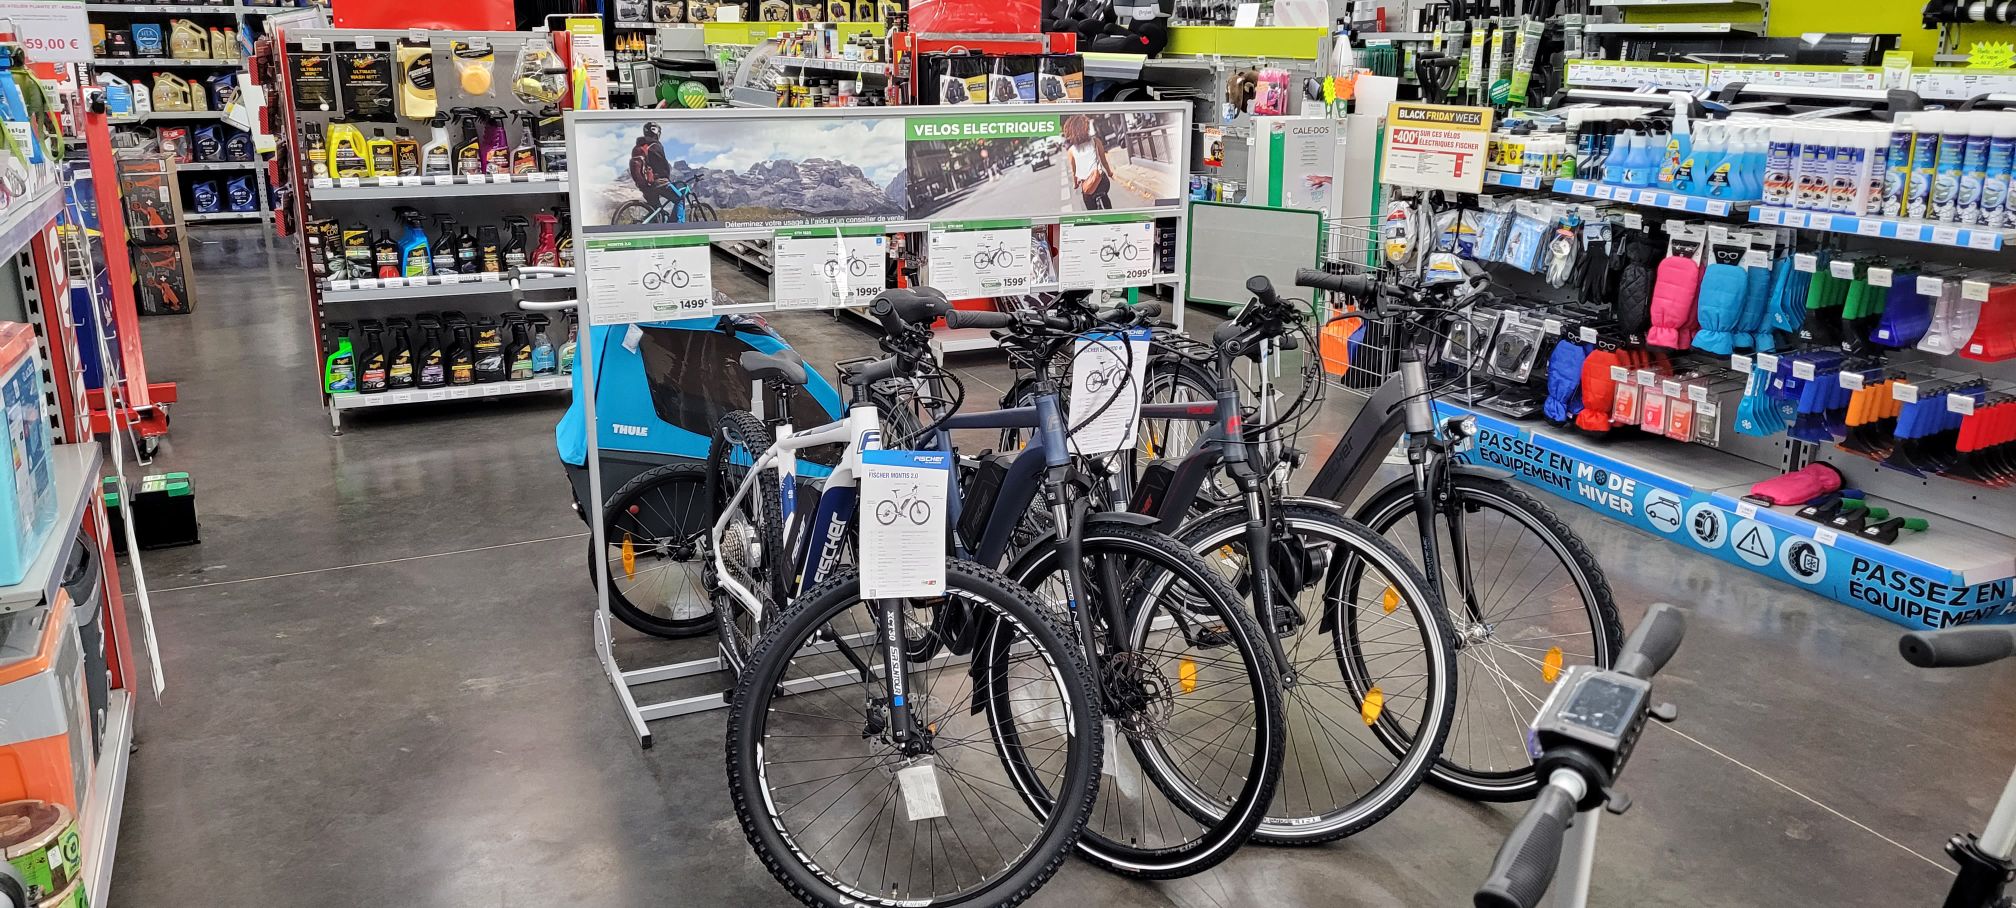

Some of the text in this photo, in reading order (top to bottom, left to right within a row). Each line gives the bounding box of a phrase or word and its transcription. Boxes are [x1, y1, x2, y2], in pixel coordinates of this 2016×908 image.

[1399, 109, 1480, 124] BLACK FRIDAY WEEK
[914, 121, 1055, 136] VELOS ELECTRIQUES
[1292, 126, 1329, 135] CALE-DOS
[1431, 130, 1442, 138] CES
[1443, 130, 1461, 139] VÉLOS
[1419, 138, 1479, 150] ÉLECTRIQUES FISCHER
[612, 423, 649, 437] THULE
[1479, 429, 1545, 464] PASSEZ
[1549, 453, 1573, 474] EN
[1479, 443, 1634, 517] ÉQUIPEMENT HIVER
[1851, 557, 2006, 606] PASSEZ EN
[1849, 577, 2001, 629] ÉQUIPEMENT
[886, 610, 897, 641] XCT30
[892, 661, 901, 694] SUNTOUR
